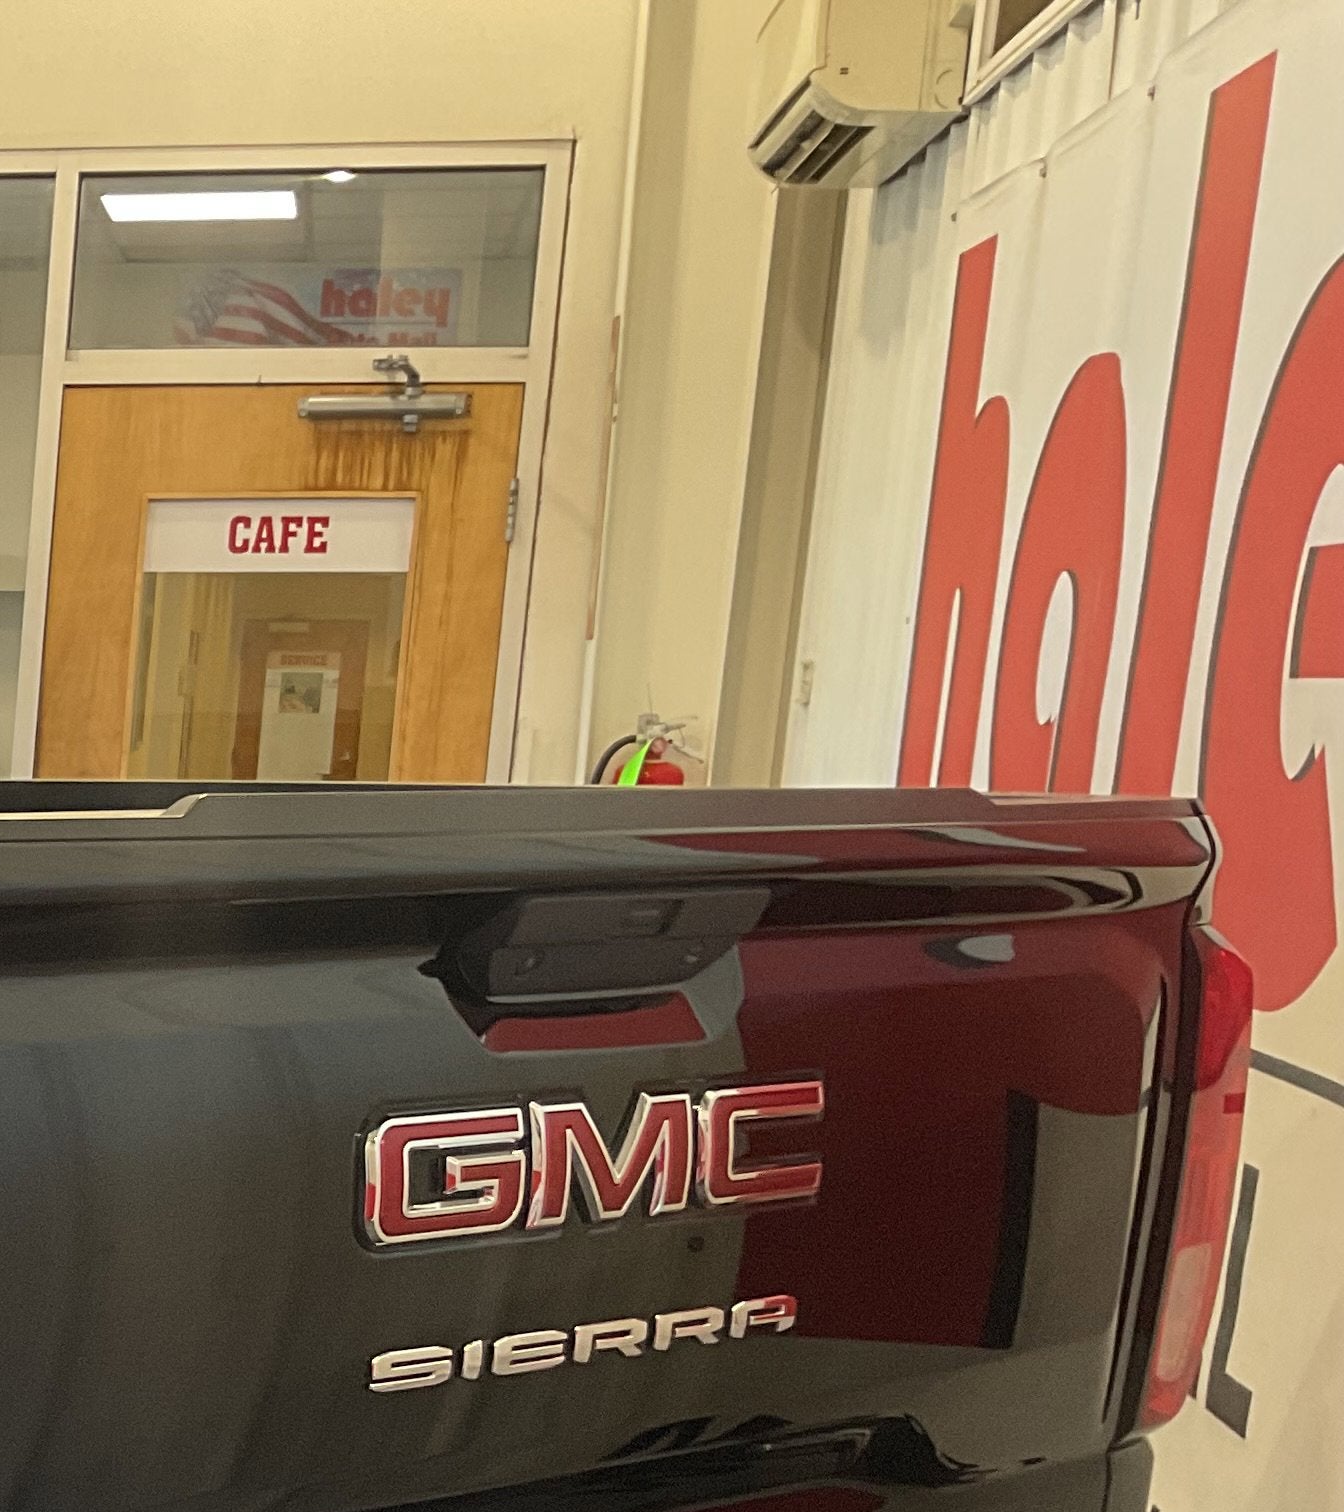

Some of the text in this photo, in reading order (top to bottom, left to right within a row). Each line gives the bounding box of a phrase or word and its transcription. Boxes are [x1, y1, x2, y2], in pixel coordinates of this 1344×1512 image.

[321, 277, 452, 328] haley
[227, 514, 331, 555] CAFE
[364, 1079, 825, 1245] GMC
[368, 1294, 799, 1393] SIERRA
